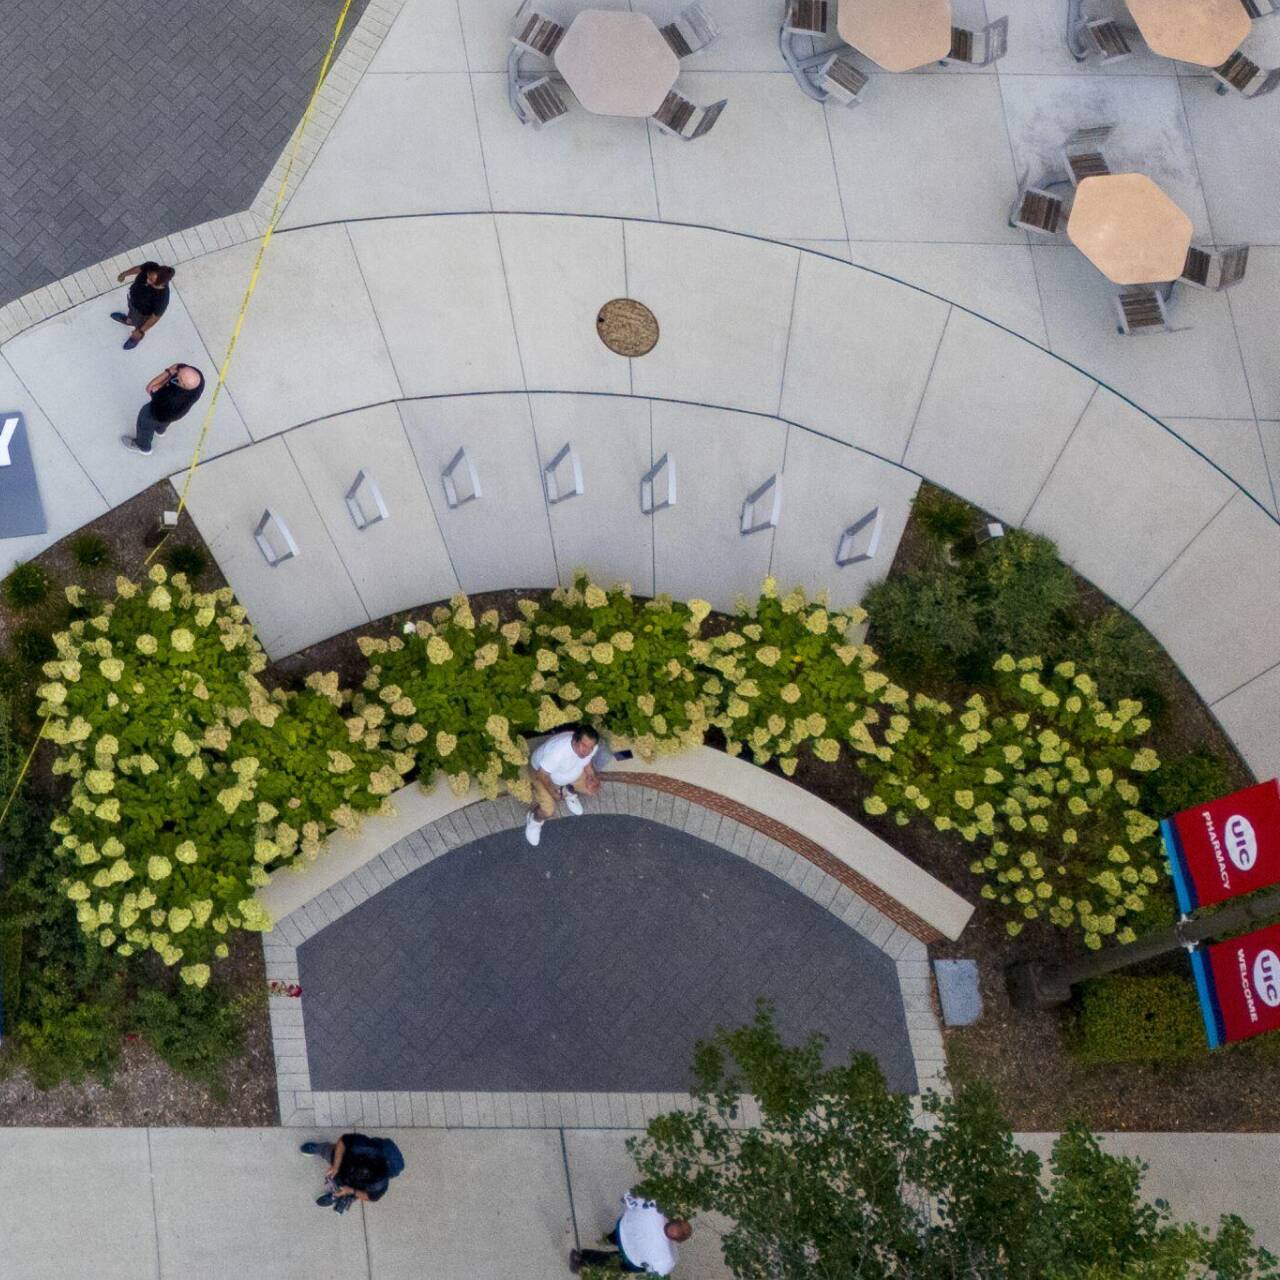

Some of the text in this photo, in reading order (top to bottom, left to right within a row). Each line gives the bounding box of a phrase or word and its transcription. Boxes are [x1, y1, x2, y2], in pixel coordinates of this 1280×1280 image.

[1202, 811, 1231, 889] PHARMACY
[1231, 820, 1251, 866] UIC
[1237, 948, 1259, 1023] WELCOME
[1260, 954, 1278, 1002] UIC
